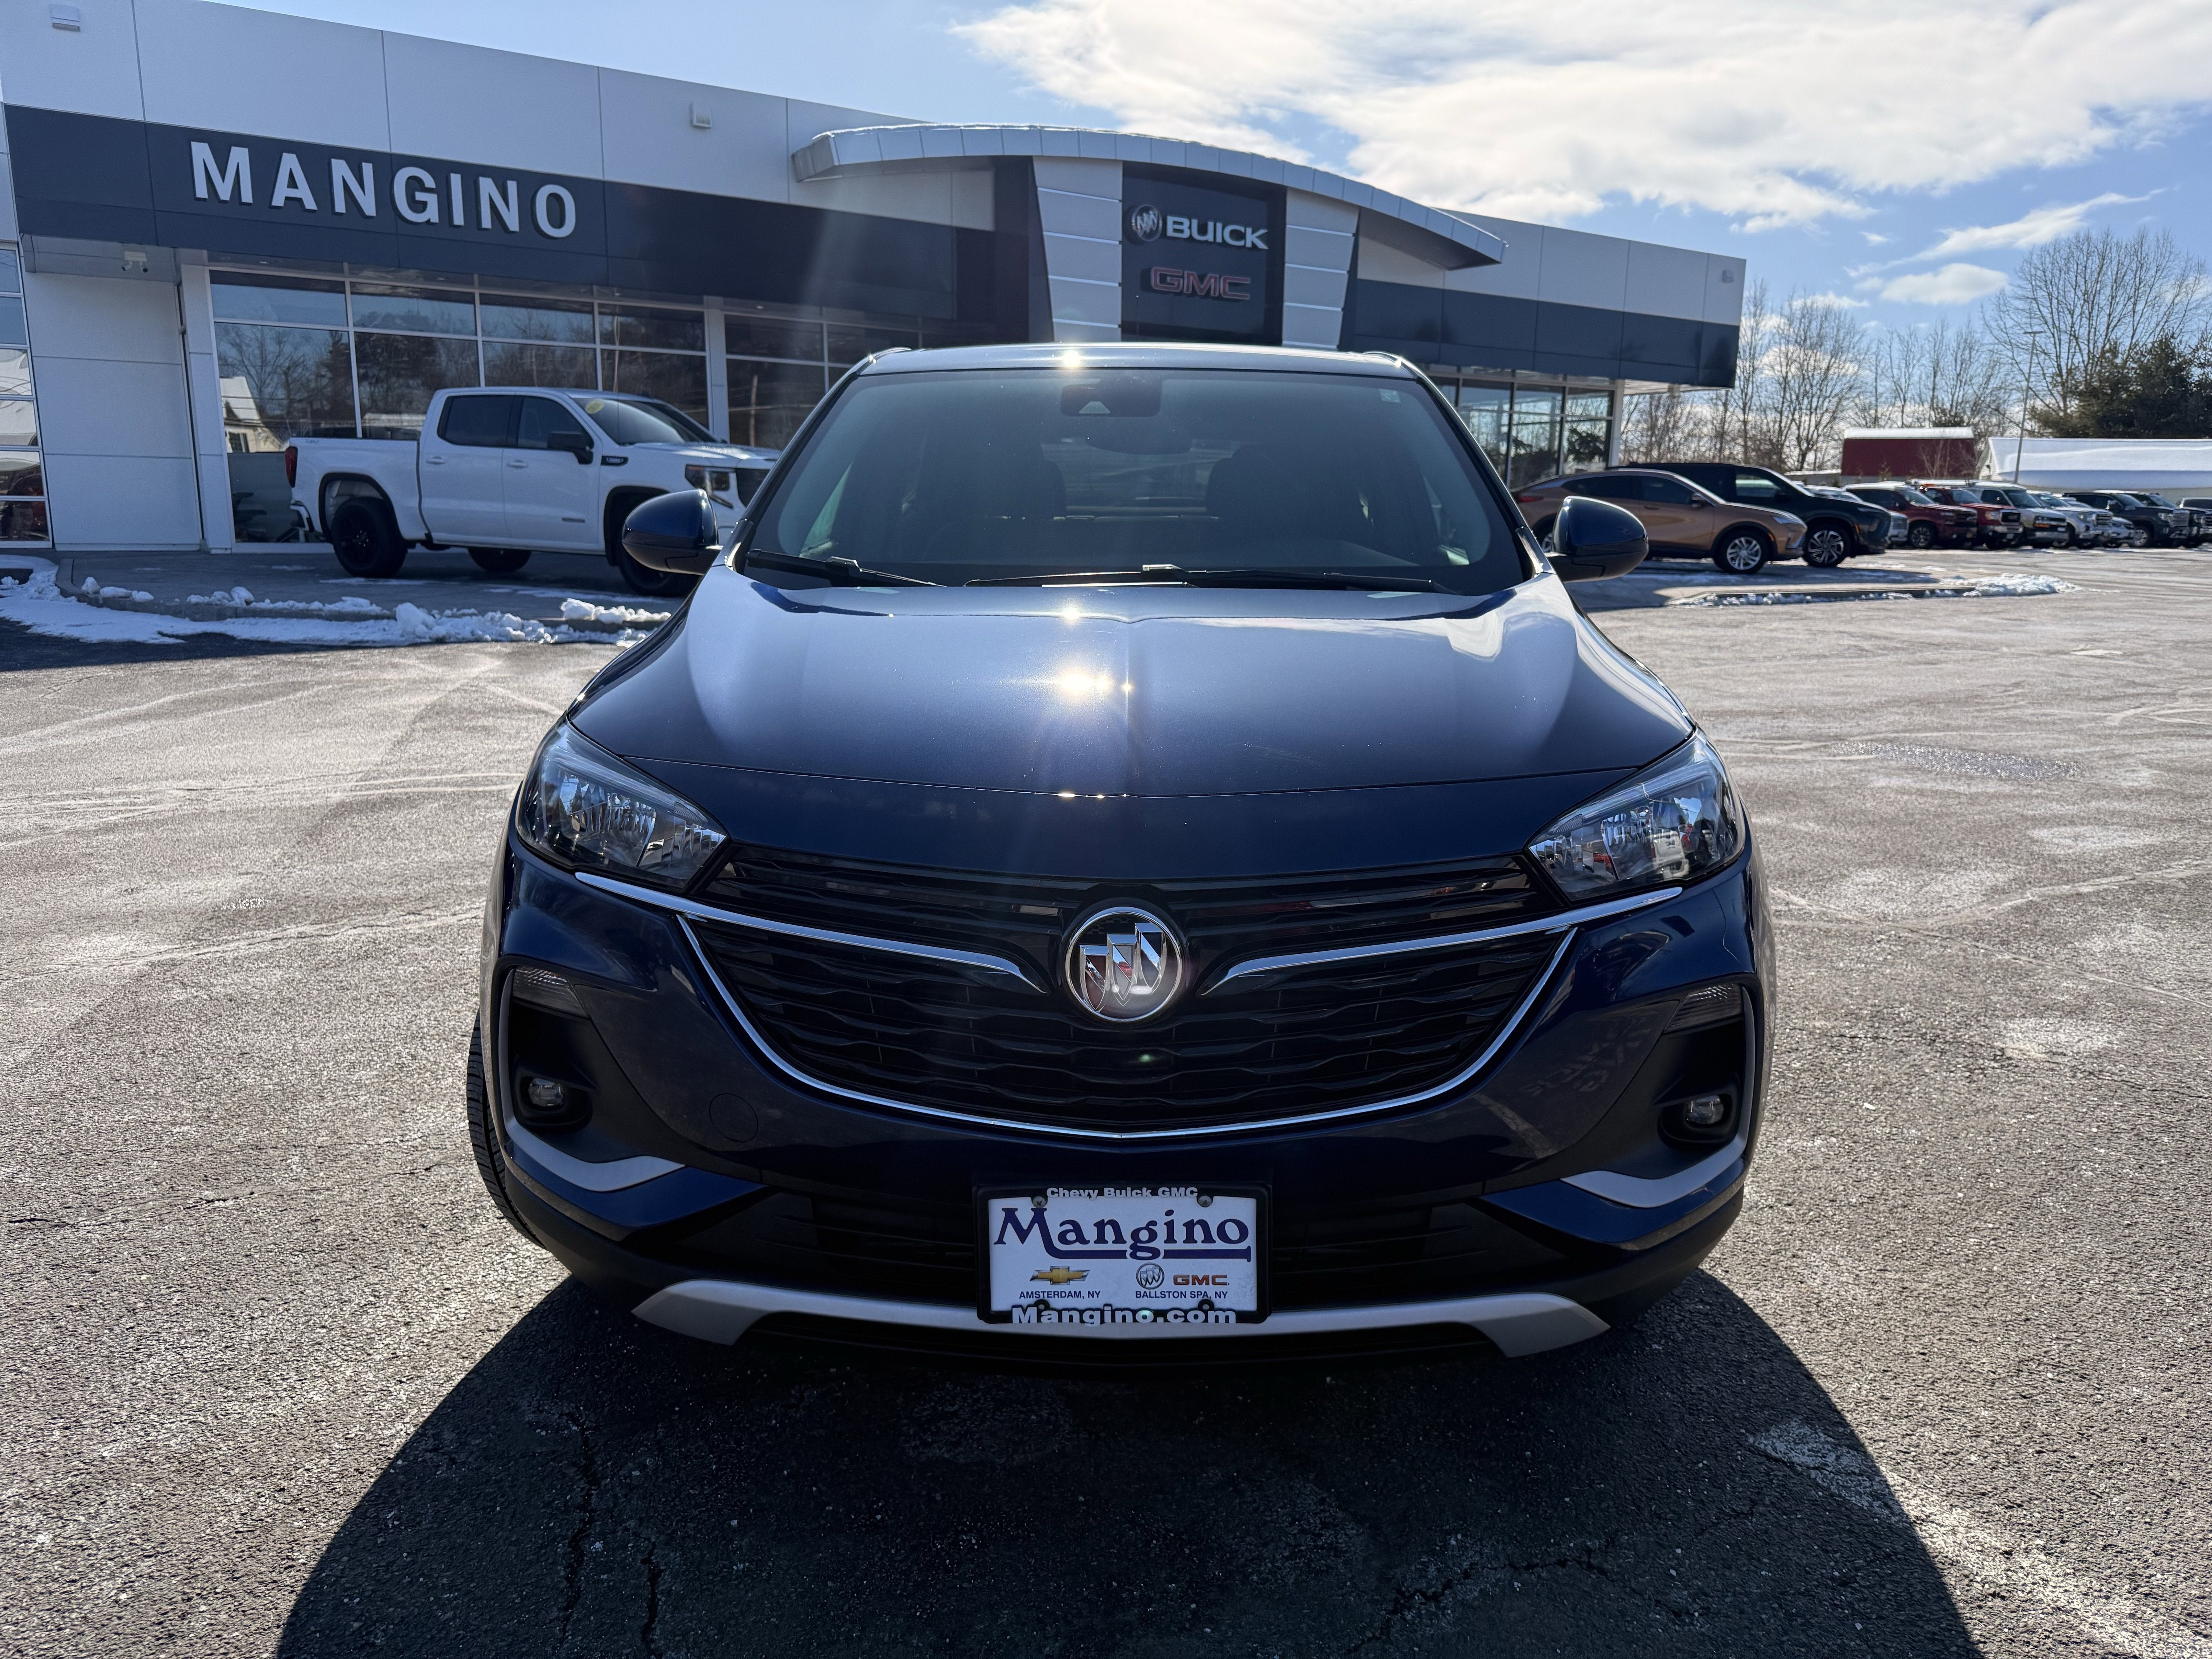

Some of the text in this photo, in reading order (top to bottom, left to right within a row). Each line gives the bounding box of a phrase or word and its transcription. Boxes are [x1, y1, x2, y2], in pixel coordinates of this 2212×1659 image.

[191, 141, 576, 239] MANGINO
[1166, 215, 1269, 250] BUICK
[1151, 267, 1251, 300] GMC
[1046, 1187, 1198, 1200] Chevy Buick GMC
[993, 1207, 1252, 1262] Mangino
[1173, 1274, 1228, 1286] GMC
[1019, 1291, 1085, 1299] AMSTERDAM,
[1190, 1291, 1212, 1299] SPA,
[1012, 1305, 1236, 1327] Mangino.com
